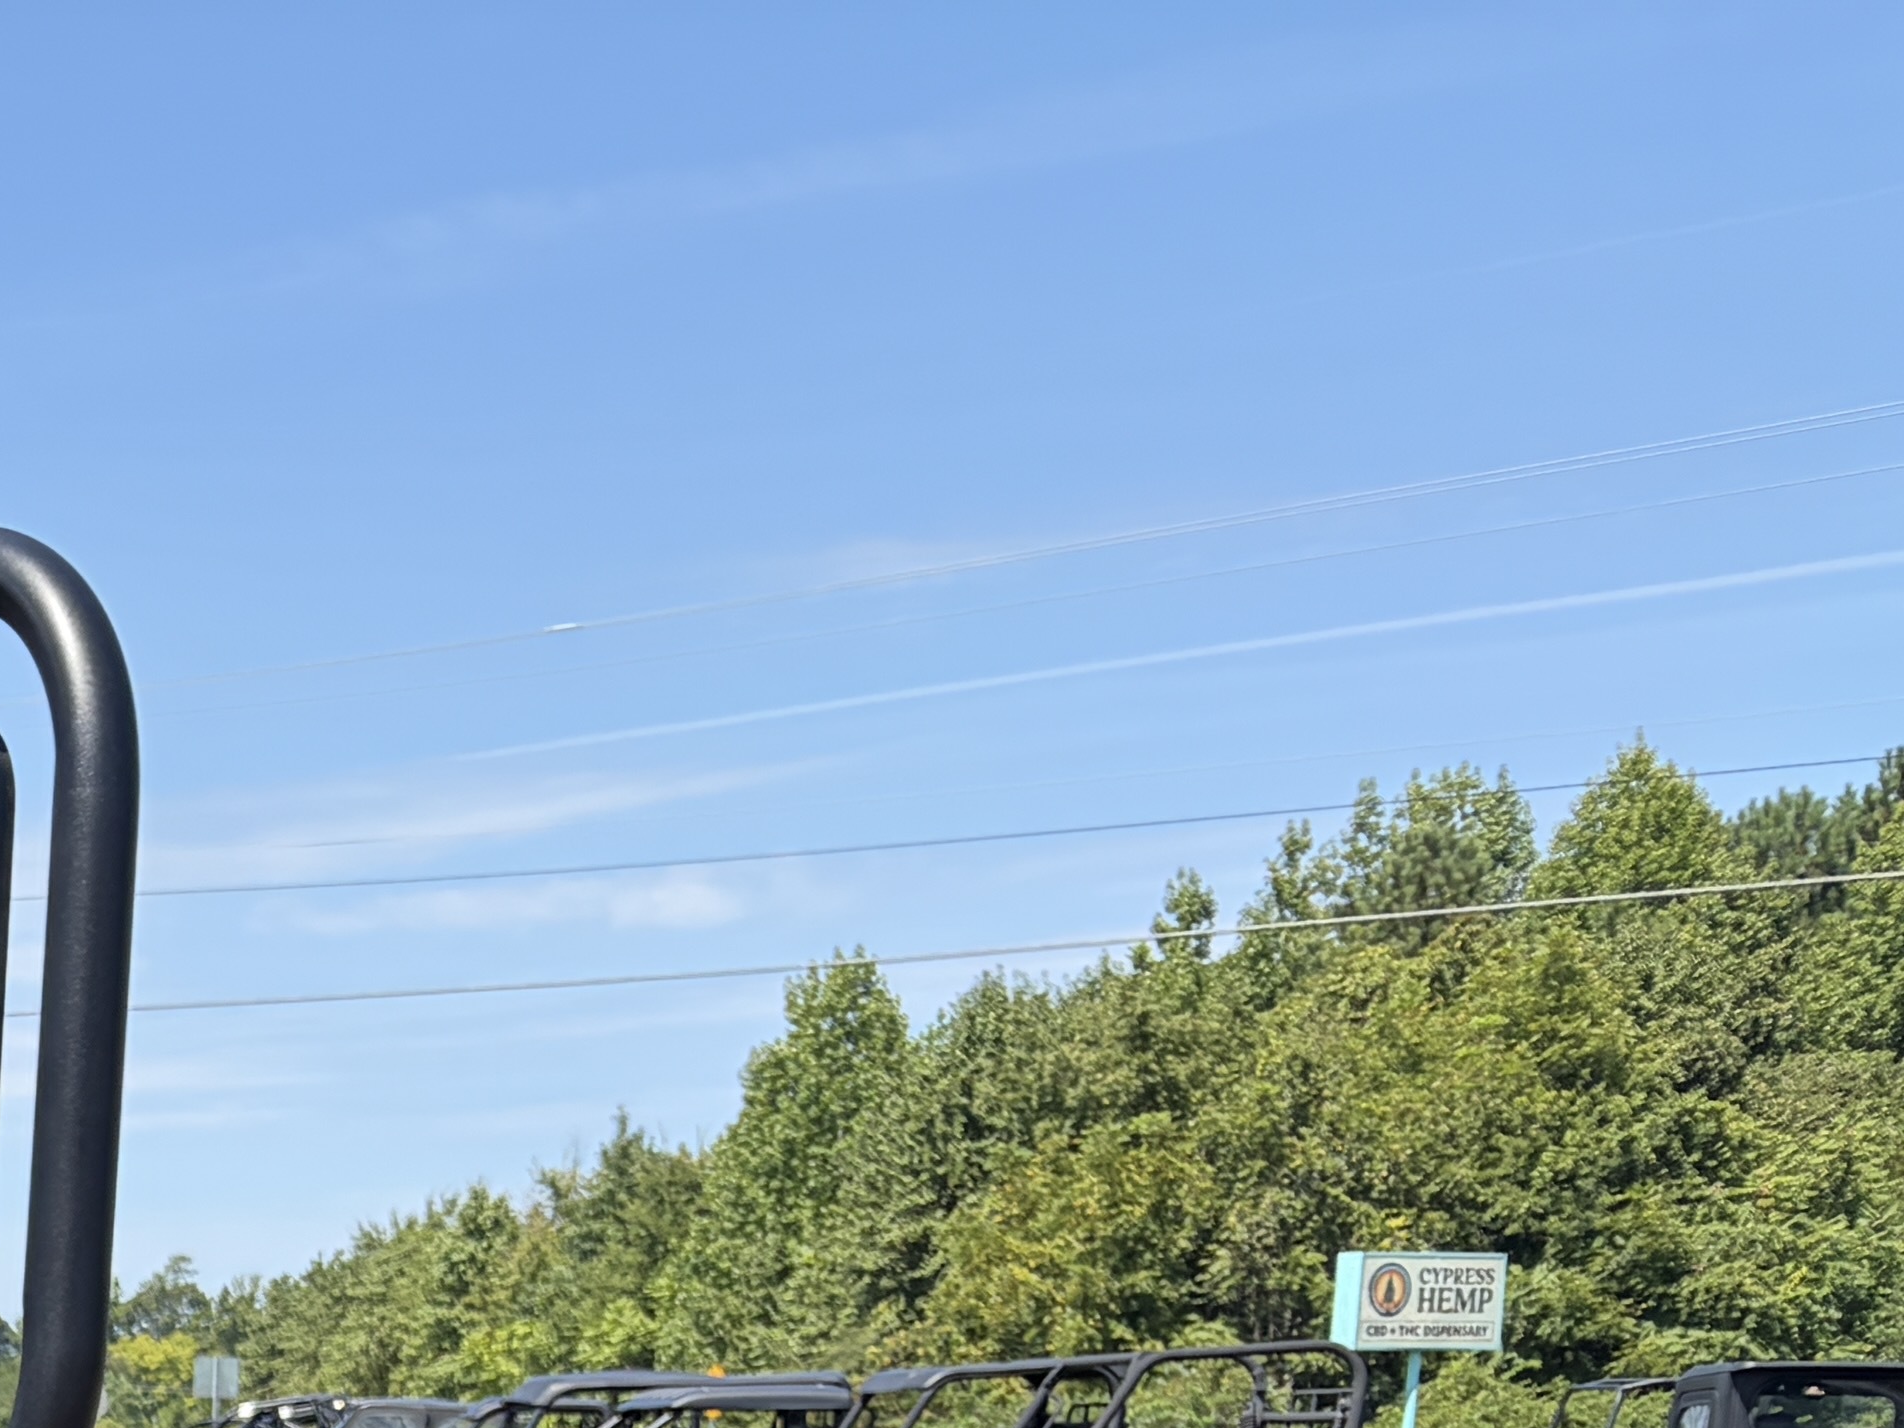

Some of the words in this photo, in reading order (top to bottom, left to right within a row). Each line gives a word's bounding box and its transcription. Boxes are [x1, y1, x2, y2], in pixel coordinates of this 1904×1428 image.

[1419, 1267, 1496, 1286] CYPRESS
[1417, 1287, 1495, 1314] HEMP
[1423, 1325, 1489, 1338] DISPENSARY
